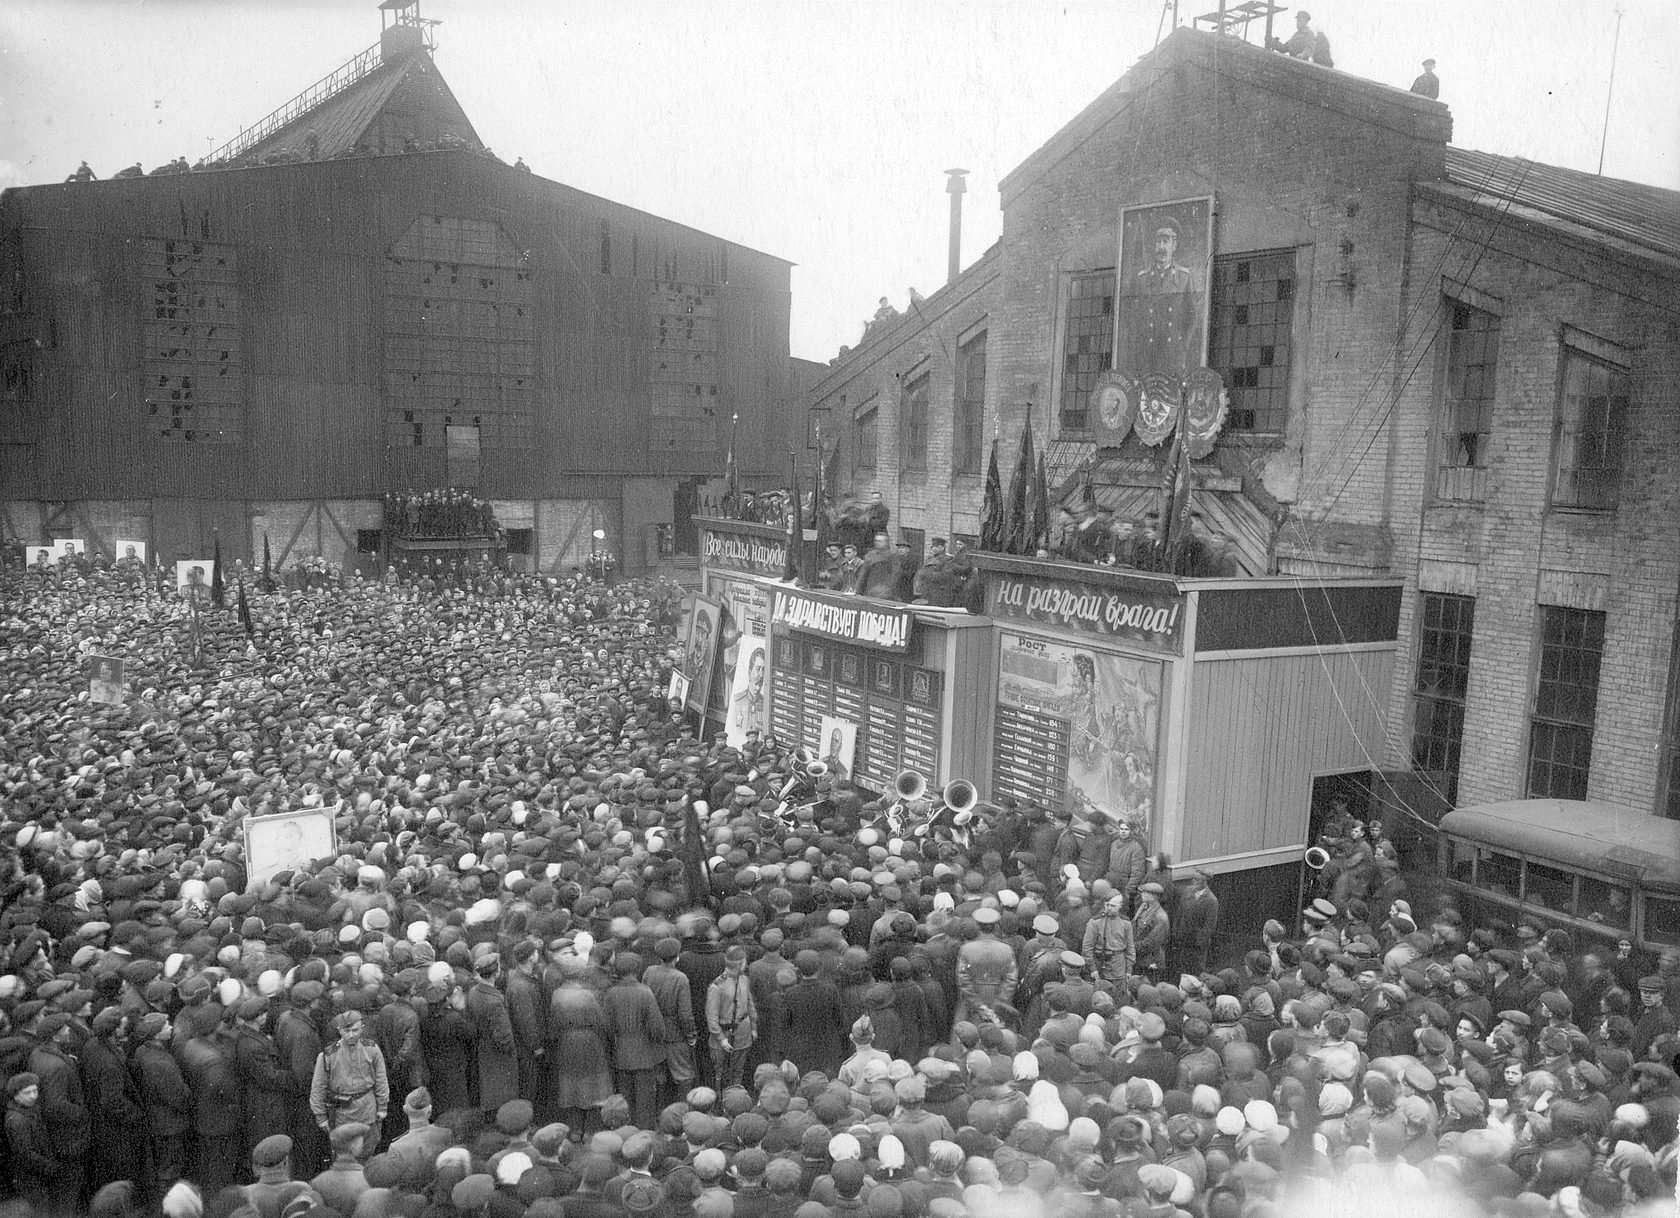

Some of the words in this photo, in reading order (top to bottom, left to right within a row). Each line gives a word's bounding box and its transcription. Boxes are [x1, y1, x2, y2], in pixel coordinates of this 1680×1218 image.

[705, 532, 721, 556] Все
[725, 540, 750, 561] силы
[751, 542, 787, 567] народа
[771, 591, 787, 623] ДА
[785, 596, 858, 638] ЗДРАВСТВУЕТ
[997, 580, 1024, 606] На
[1026, 586, 1102, 623] разгром
[1105, 595, 1179, 635] врага!
